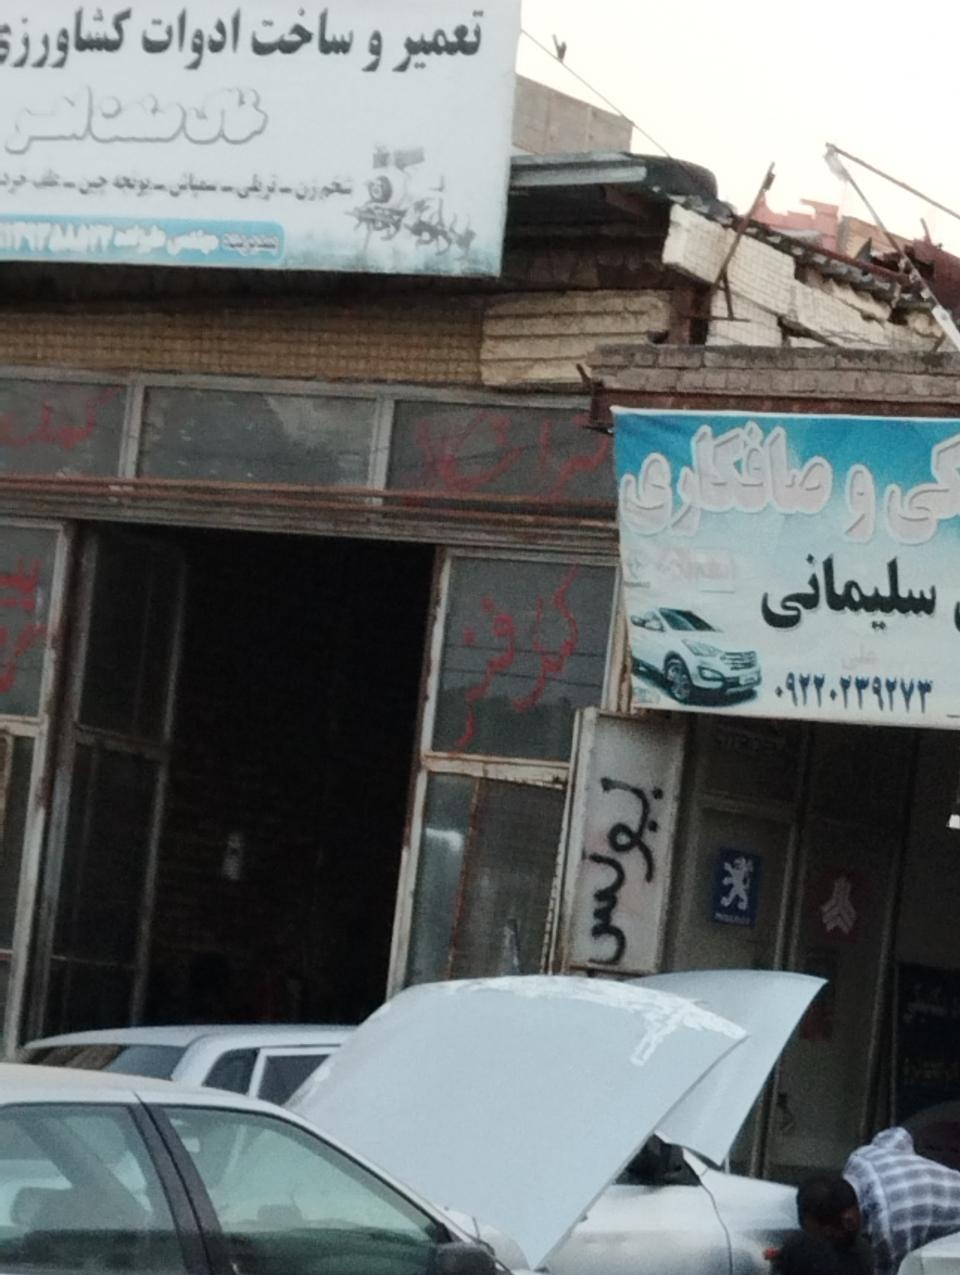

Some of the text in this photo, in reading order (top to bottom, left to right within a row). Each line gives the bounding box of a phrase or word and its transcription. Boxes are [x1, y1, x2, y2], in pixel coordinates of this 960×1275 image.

[142, 7, 240, 70] ادوات
[251, 7, 353, 56] ساخت
[361, 29, 382, 72] و
[392, 9, 484, 72] تعمیر
[619, 421, 833, 536] صافکاری
[845, 464, 876, 543] و
[761, 552, 937, 632] سلیمانی
